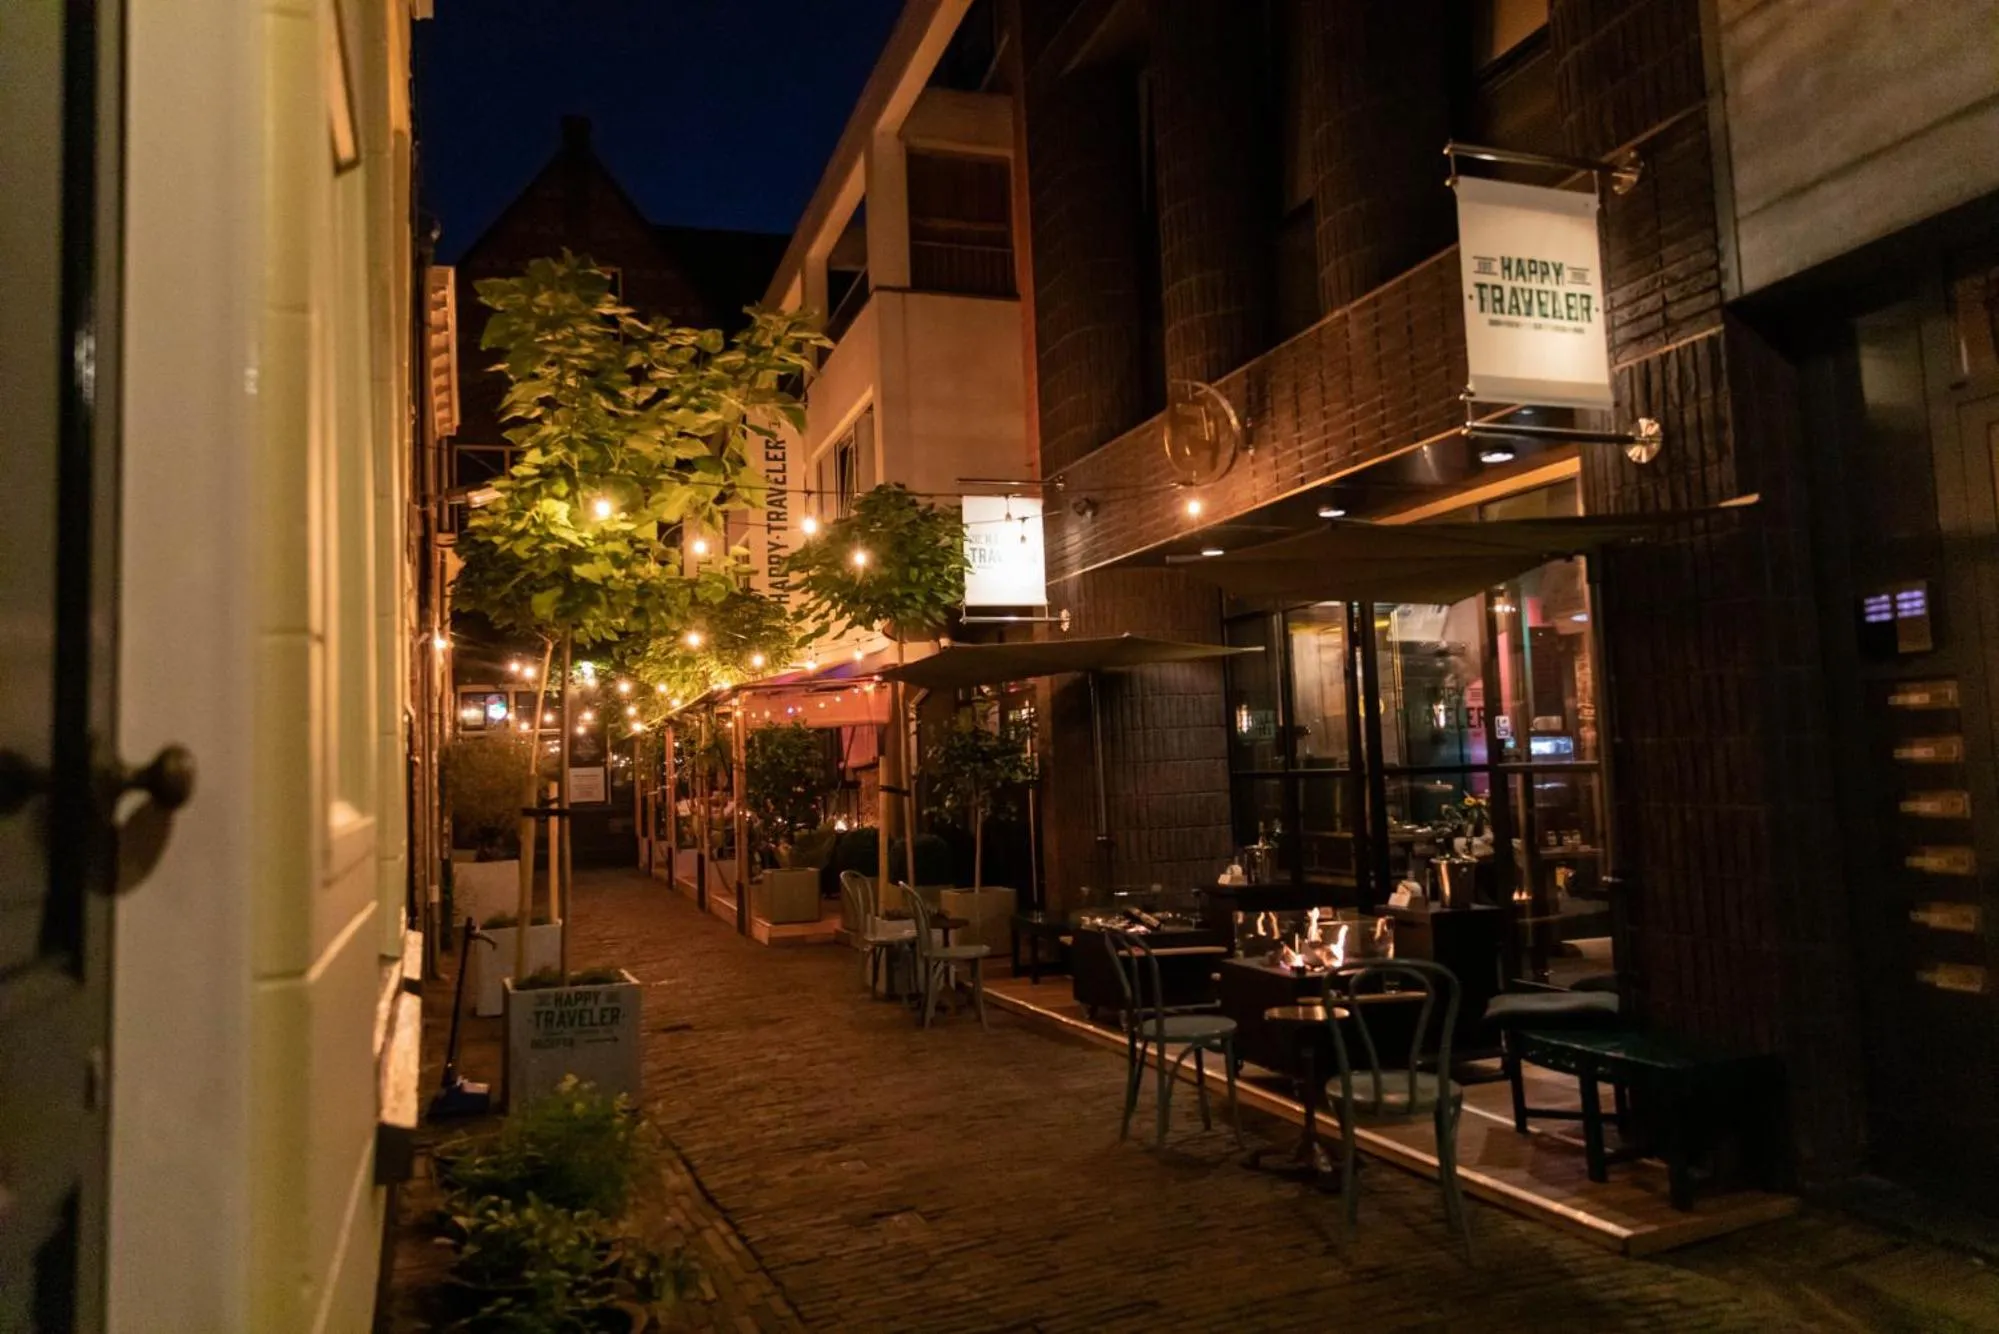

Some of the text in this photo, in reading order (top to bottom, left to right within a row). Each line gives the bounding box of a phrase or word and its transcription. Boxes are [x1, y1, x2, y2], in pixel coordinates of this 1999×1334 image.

[1500, 255, 1564, 287] HAPPY
[1473, 281, 1593, 323] TRAVELER
[554, 991, 601, 1008] HAPPY
[533, 1007, 621, 1029] TRAVELER
